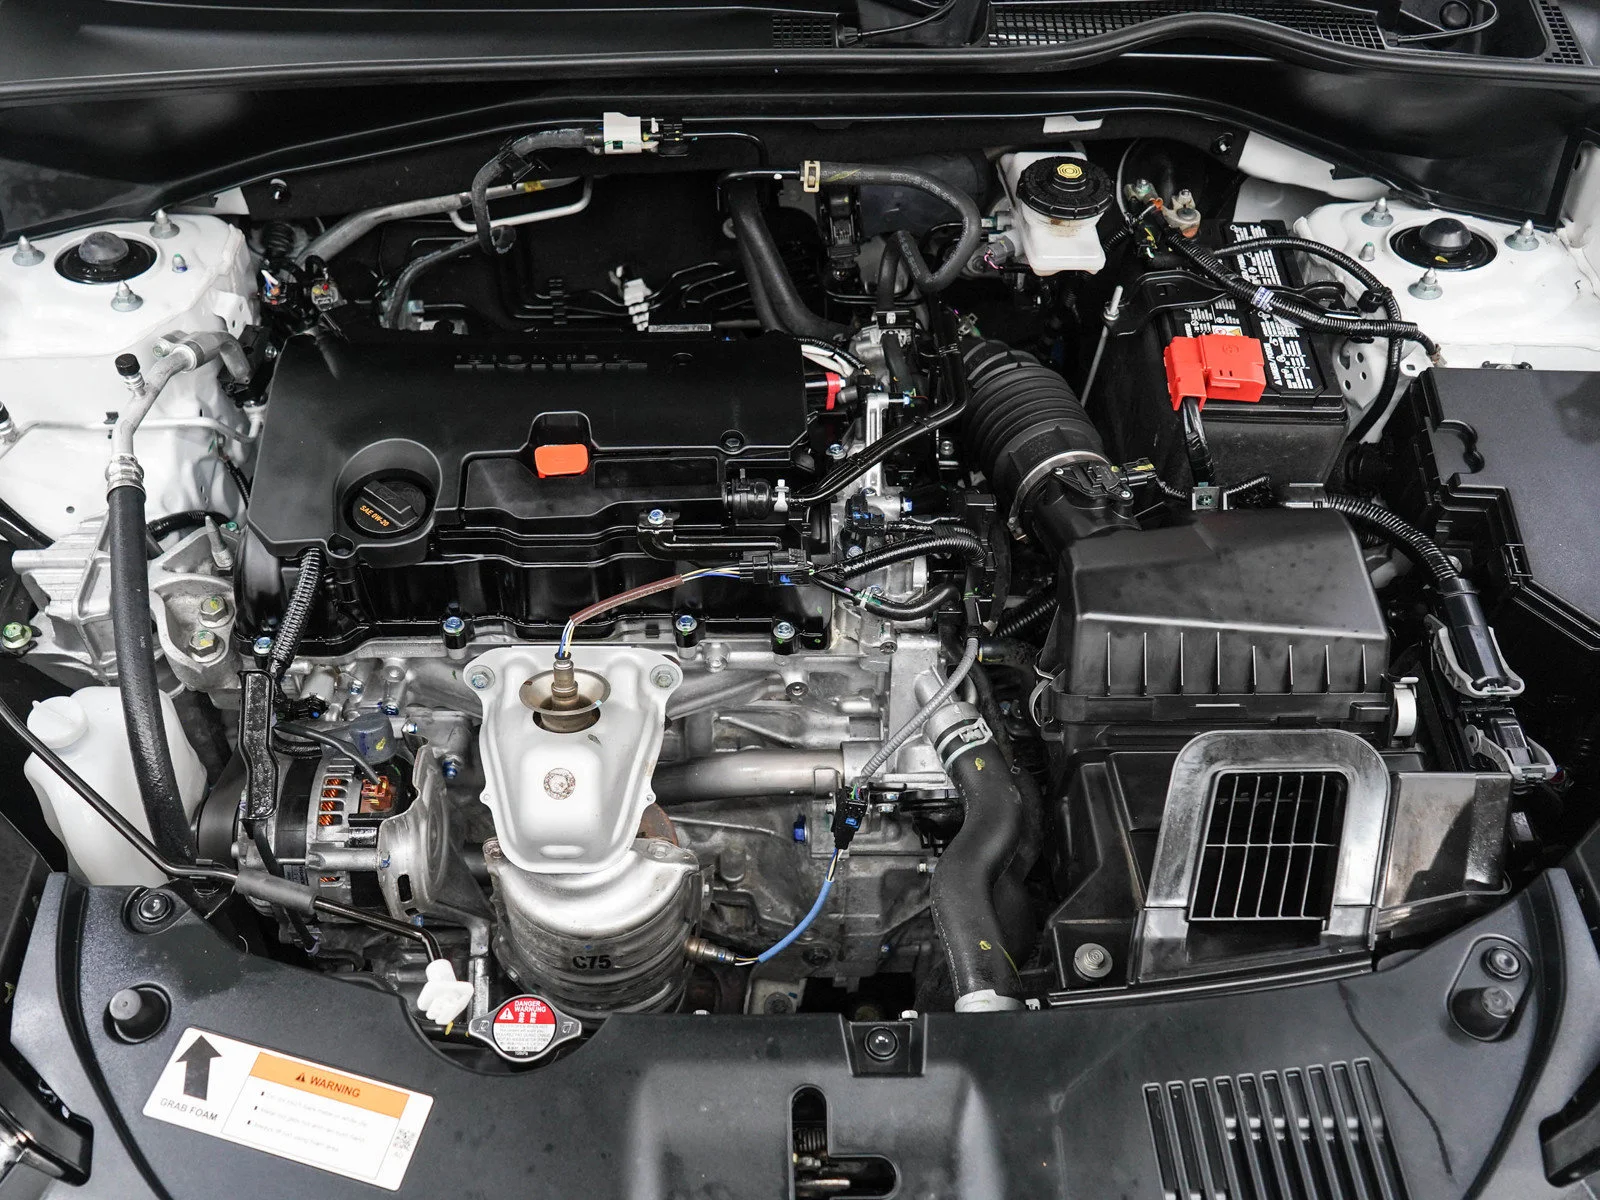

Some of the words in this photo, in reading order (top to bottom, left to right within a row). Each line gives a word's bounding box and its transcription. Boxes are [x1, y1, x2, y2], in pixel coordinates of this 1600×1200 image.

[359, 505, 373, 516] SAE
[371, 511, 390, 527] 0W-20
[573, 954, 612, 970] C75
[309, 1075, 361, 1099] WARNING
[160, 1097, 189, 1114] GRAB
[189, 1106, 219, 1122] FOAM
